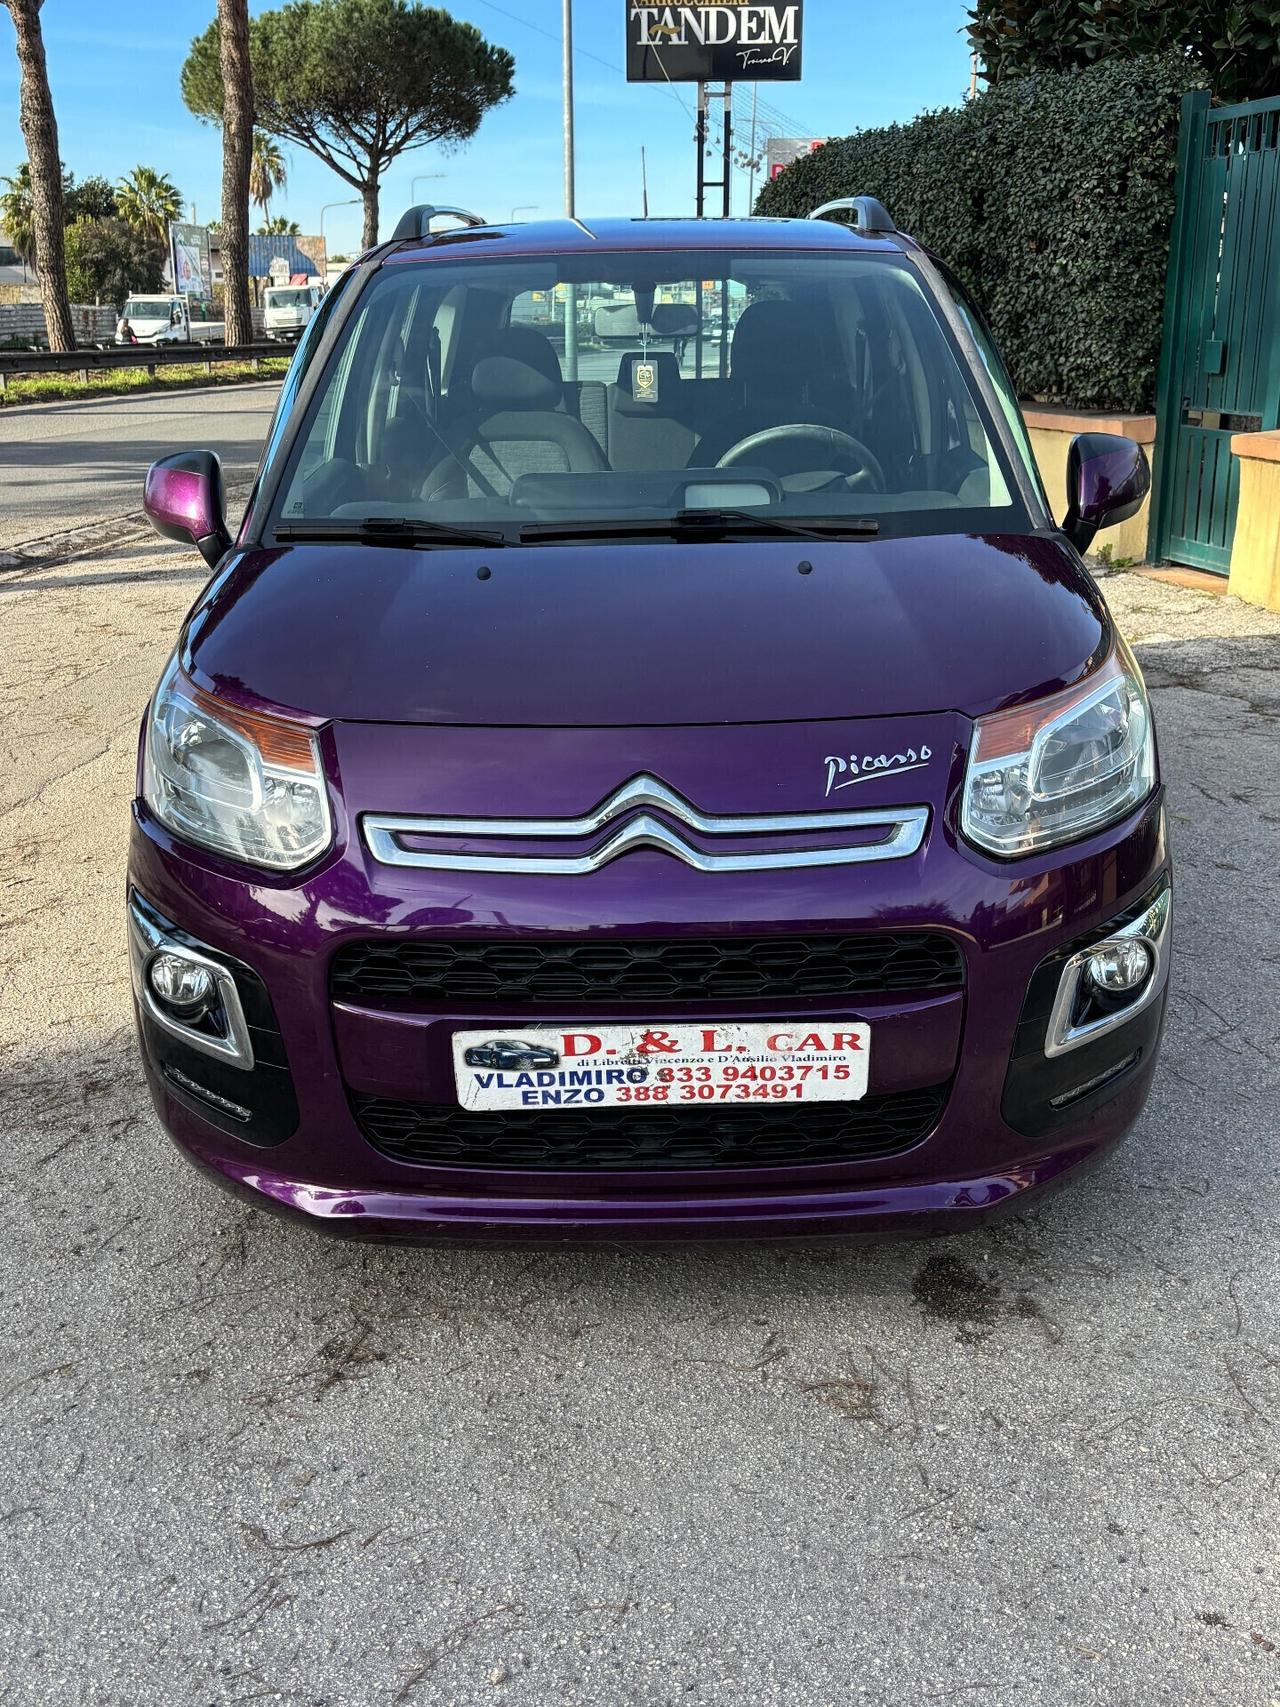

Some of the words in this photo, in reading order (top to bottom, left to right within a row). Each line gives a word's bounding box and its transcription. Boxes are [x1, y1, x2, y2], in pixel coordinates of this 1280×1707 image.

[630, 6, 799, 45] TANDEM
[561, 1033, 617, 1057] D.
[636, 1030, 682, 1054] &
[700, 1030, 747, 1054] L.
[577, 1059, 590, 1067] di
[645, 1056, 704, 1065] Vincenzo
[781, 1055, 847, 1063] Vladimiro
[474, 1068, 648, 1088] VLADIMIRO
[722, 1064, 851, 1082] 9403715
[522, 1088, 605, 1106] ENZO
[615, 1086, 669, 1102] 388
[680, 1083, 804, 1100] 3073491
